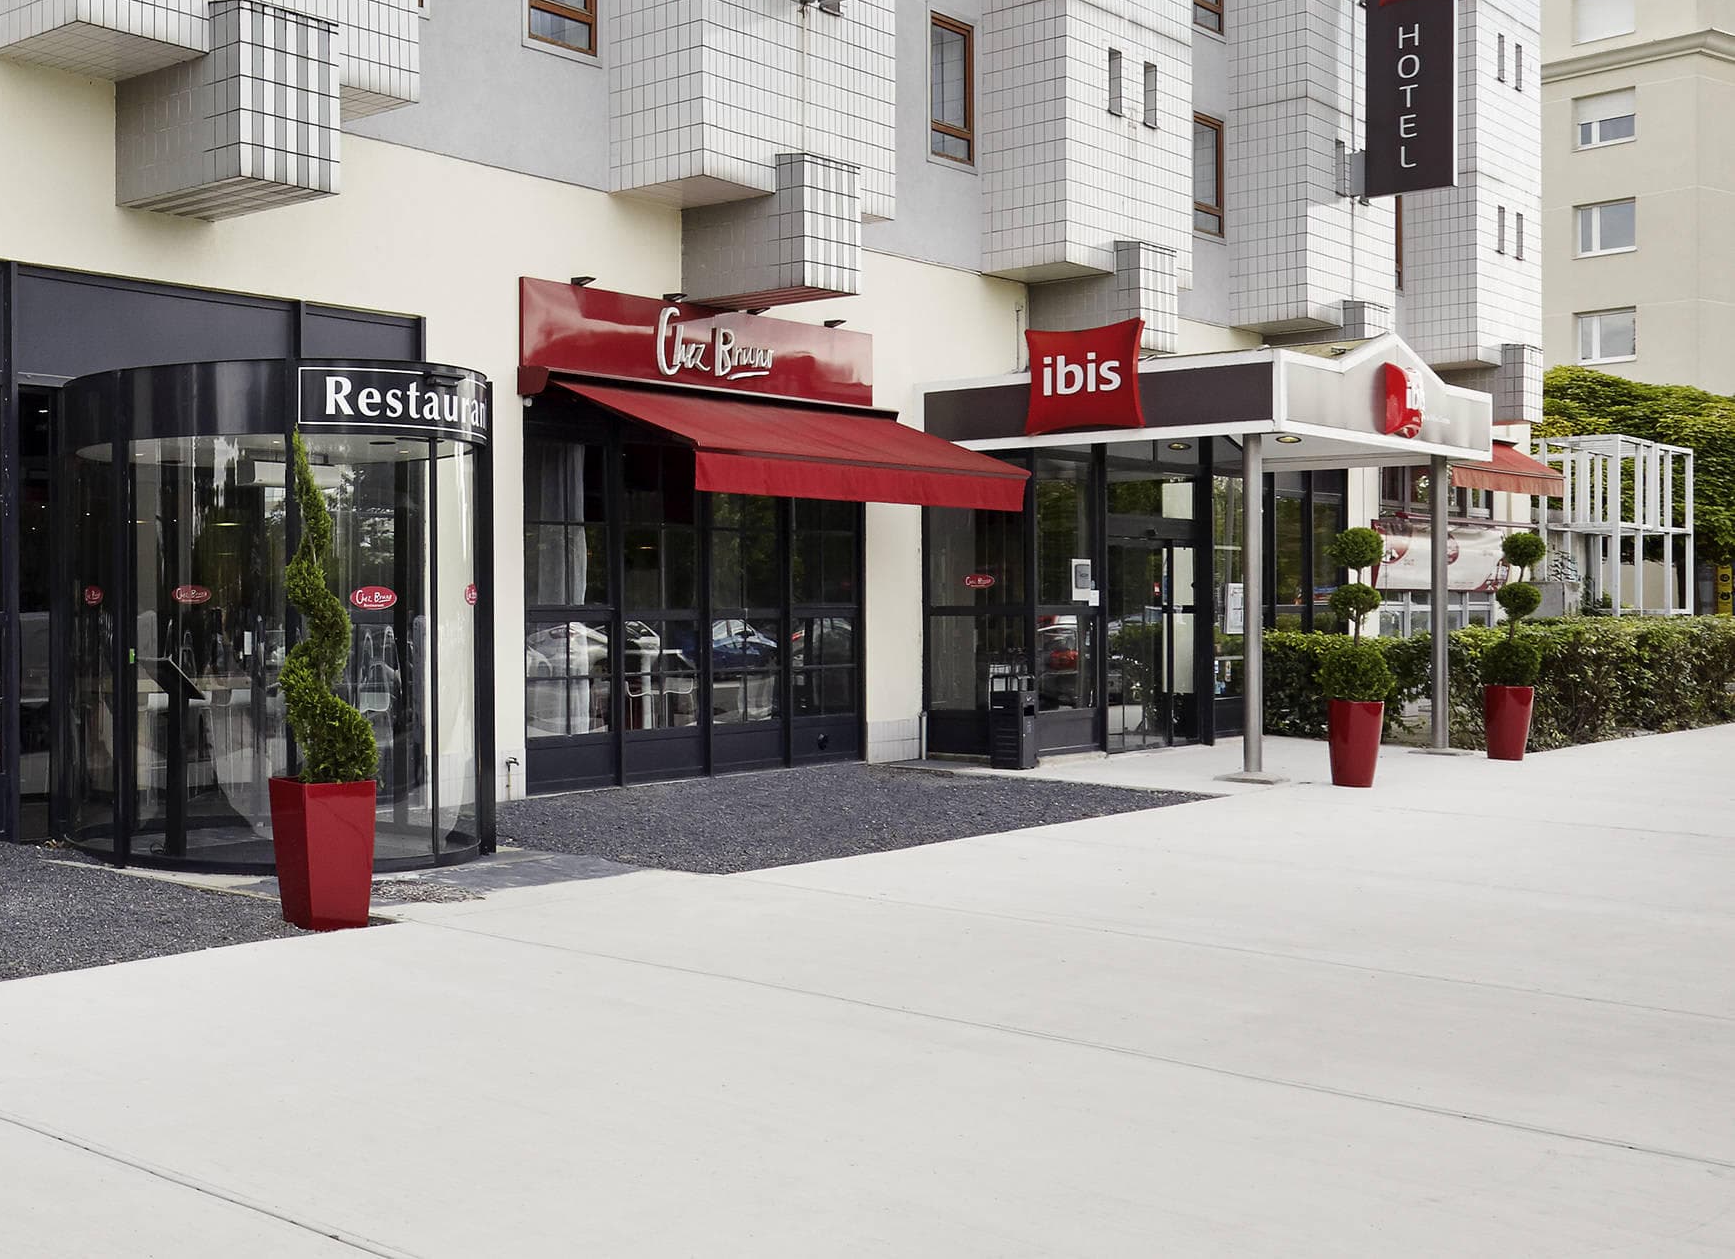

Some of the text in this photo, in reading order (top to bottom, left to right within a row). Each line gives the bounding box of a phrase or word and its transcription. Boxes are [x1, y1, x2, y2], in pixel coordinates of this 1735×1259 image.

[1397, 23, 1421, 168] HOTEL
[656, 306, 775, 377] Chez Bruno
[324, 375, 487, 430] Restauran
[1042, 351, 1123, 397] ibis
